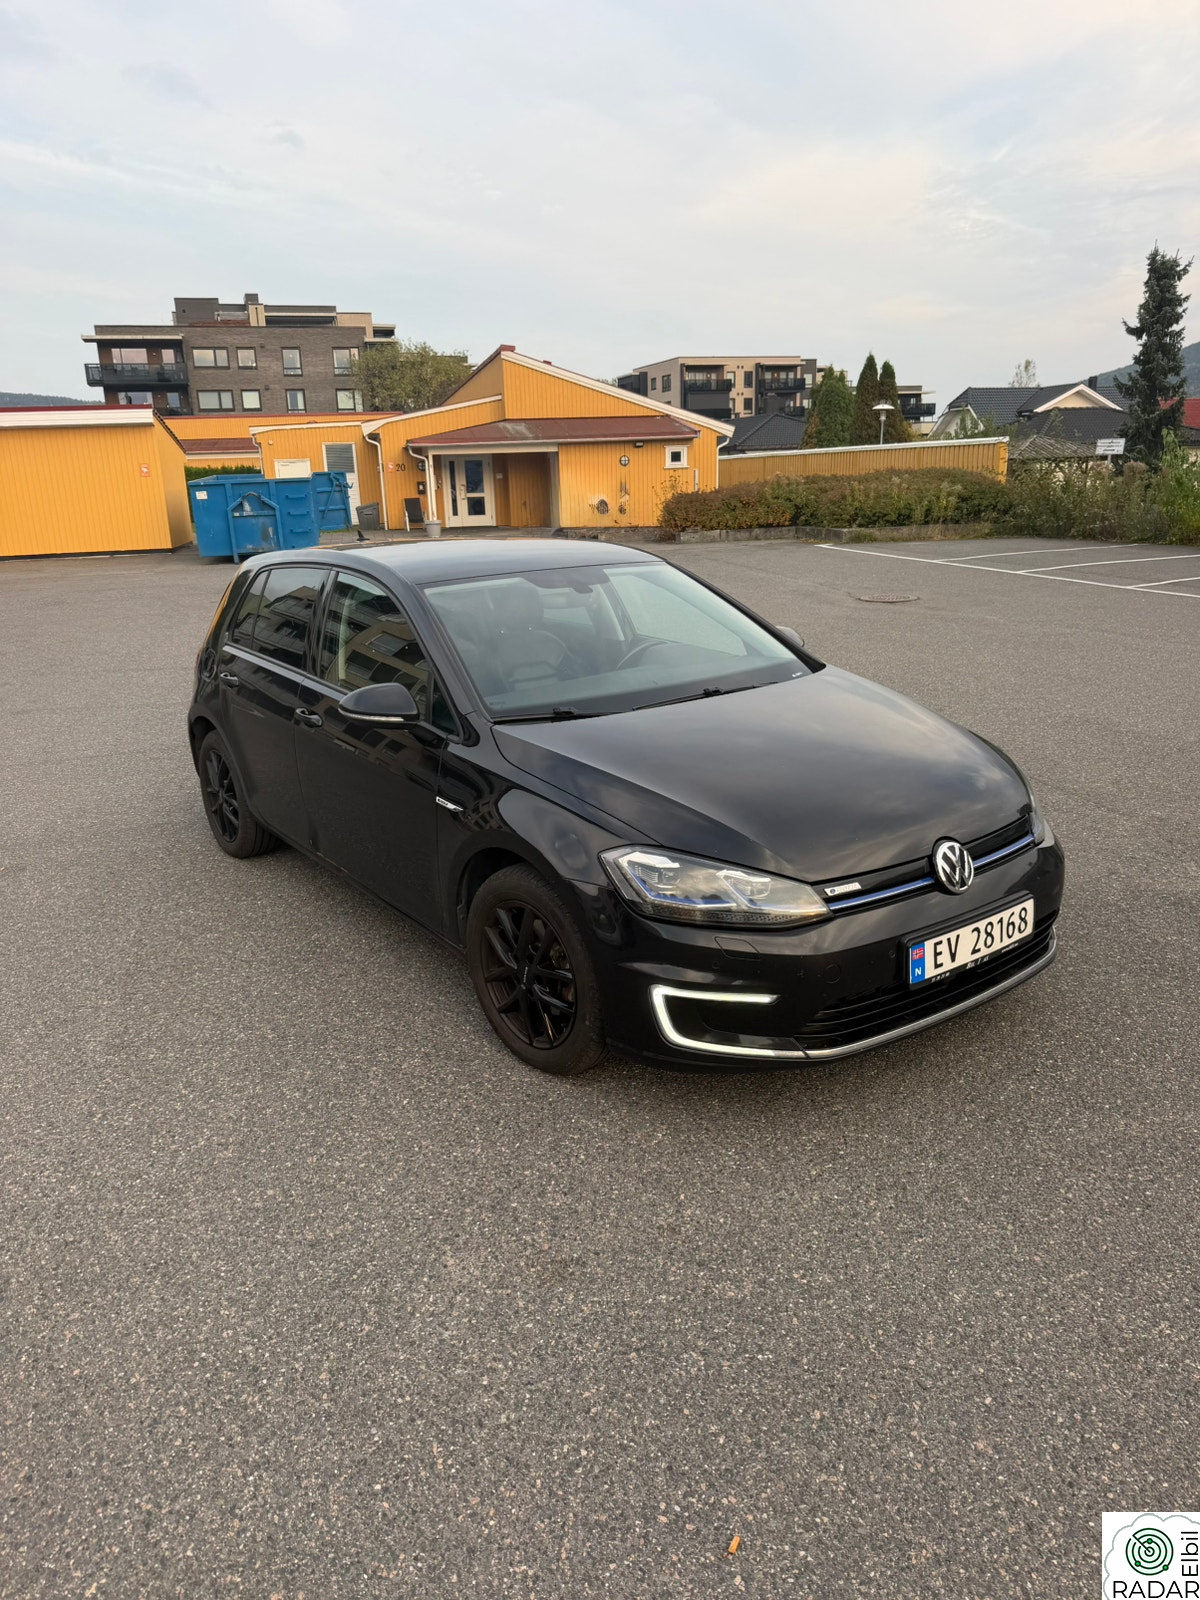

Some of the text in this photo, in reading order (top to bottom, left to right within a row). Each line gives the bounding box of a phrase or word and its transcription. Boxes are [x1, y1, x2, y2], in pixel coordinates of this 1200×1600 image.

[933, 907, 1028, 970] EV 28168
[914, 967, 922, 977] N
